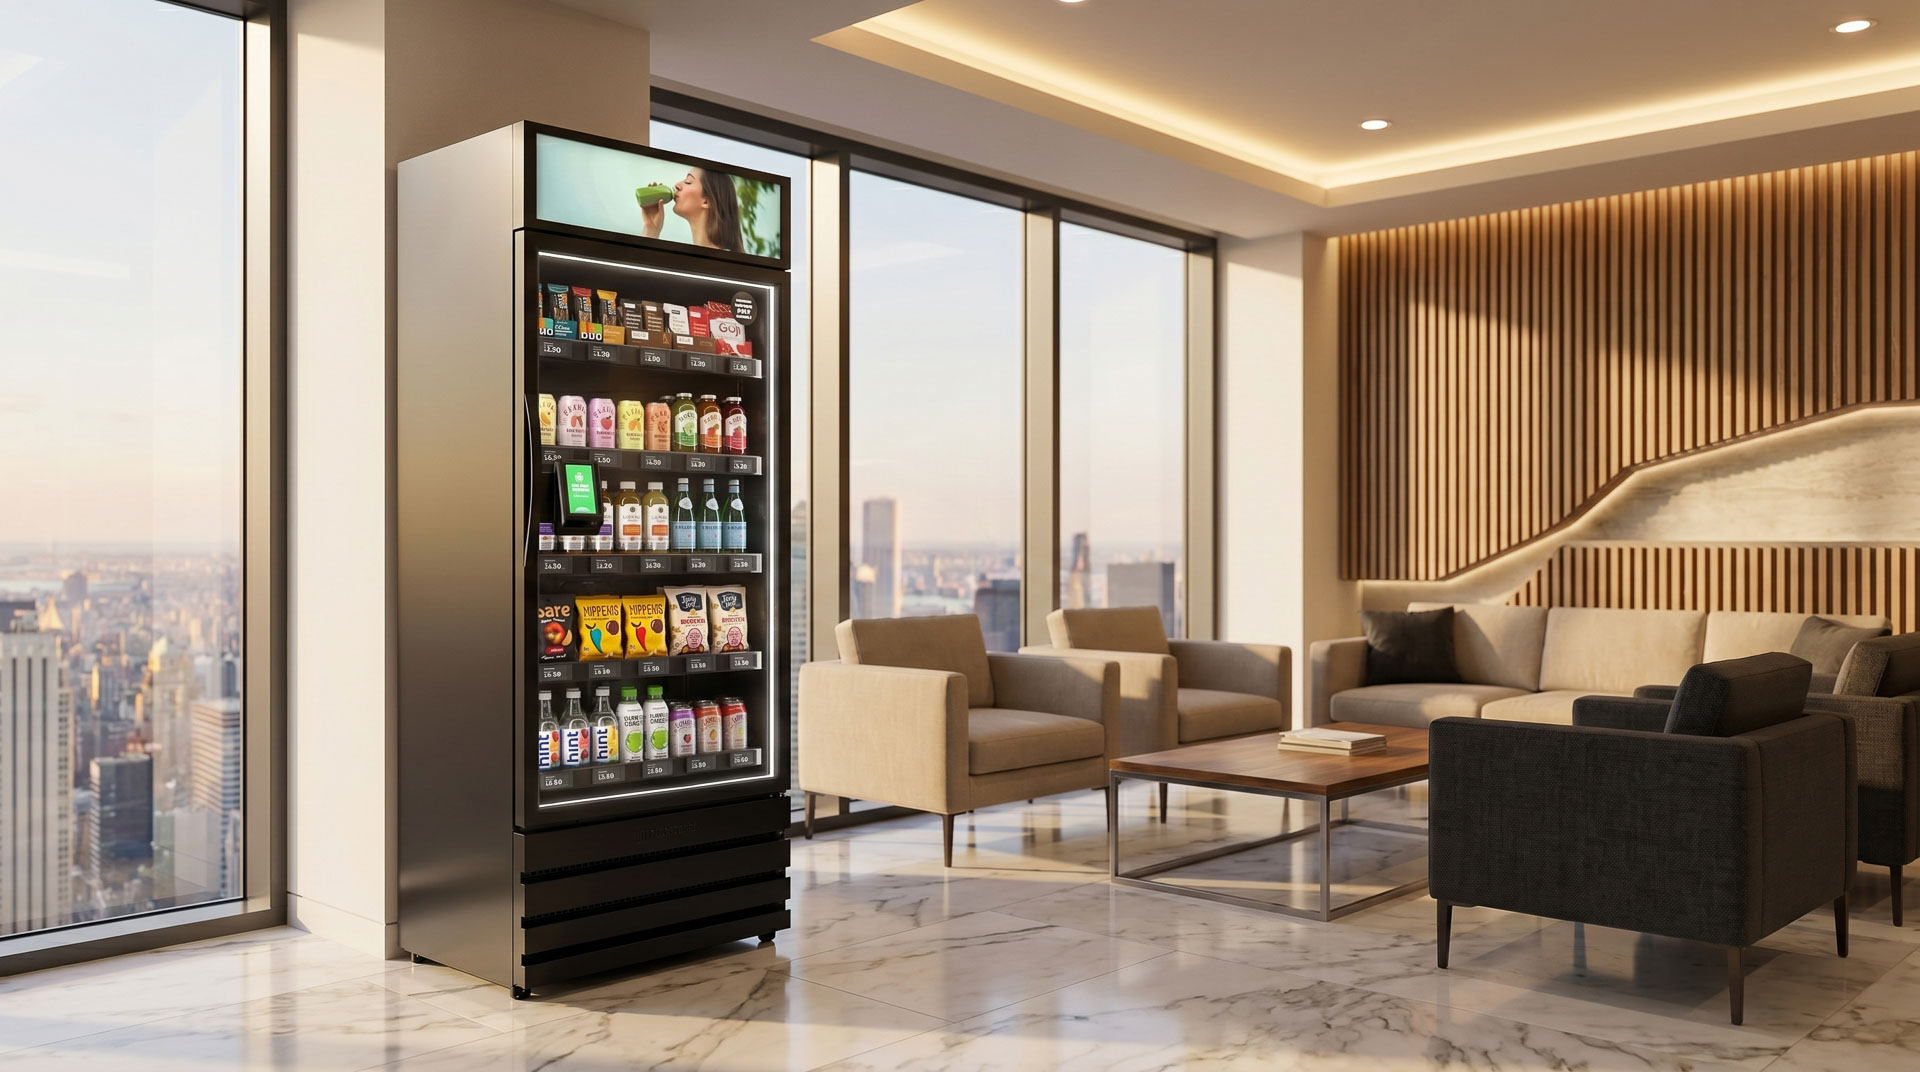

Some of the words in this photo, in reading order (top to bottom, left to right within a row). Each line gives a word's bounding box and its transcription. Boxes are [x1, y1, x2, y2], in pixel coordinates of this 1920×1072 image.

[581, 332, 602, 341] DUO
[538, 734, 550, 768] hint
[567, 731, 579, 763] hint
[597, 728, 608, 760] hint
